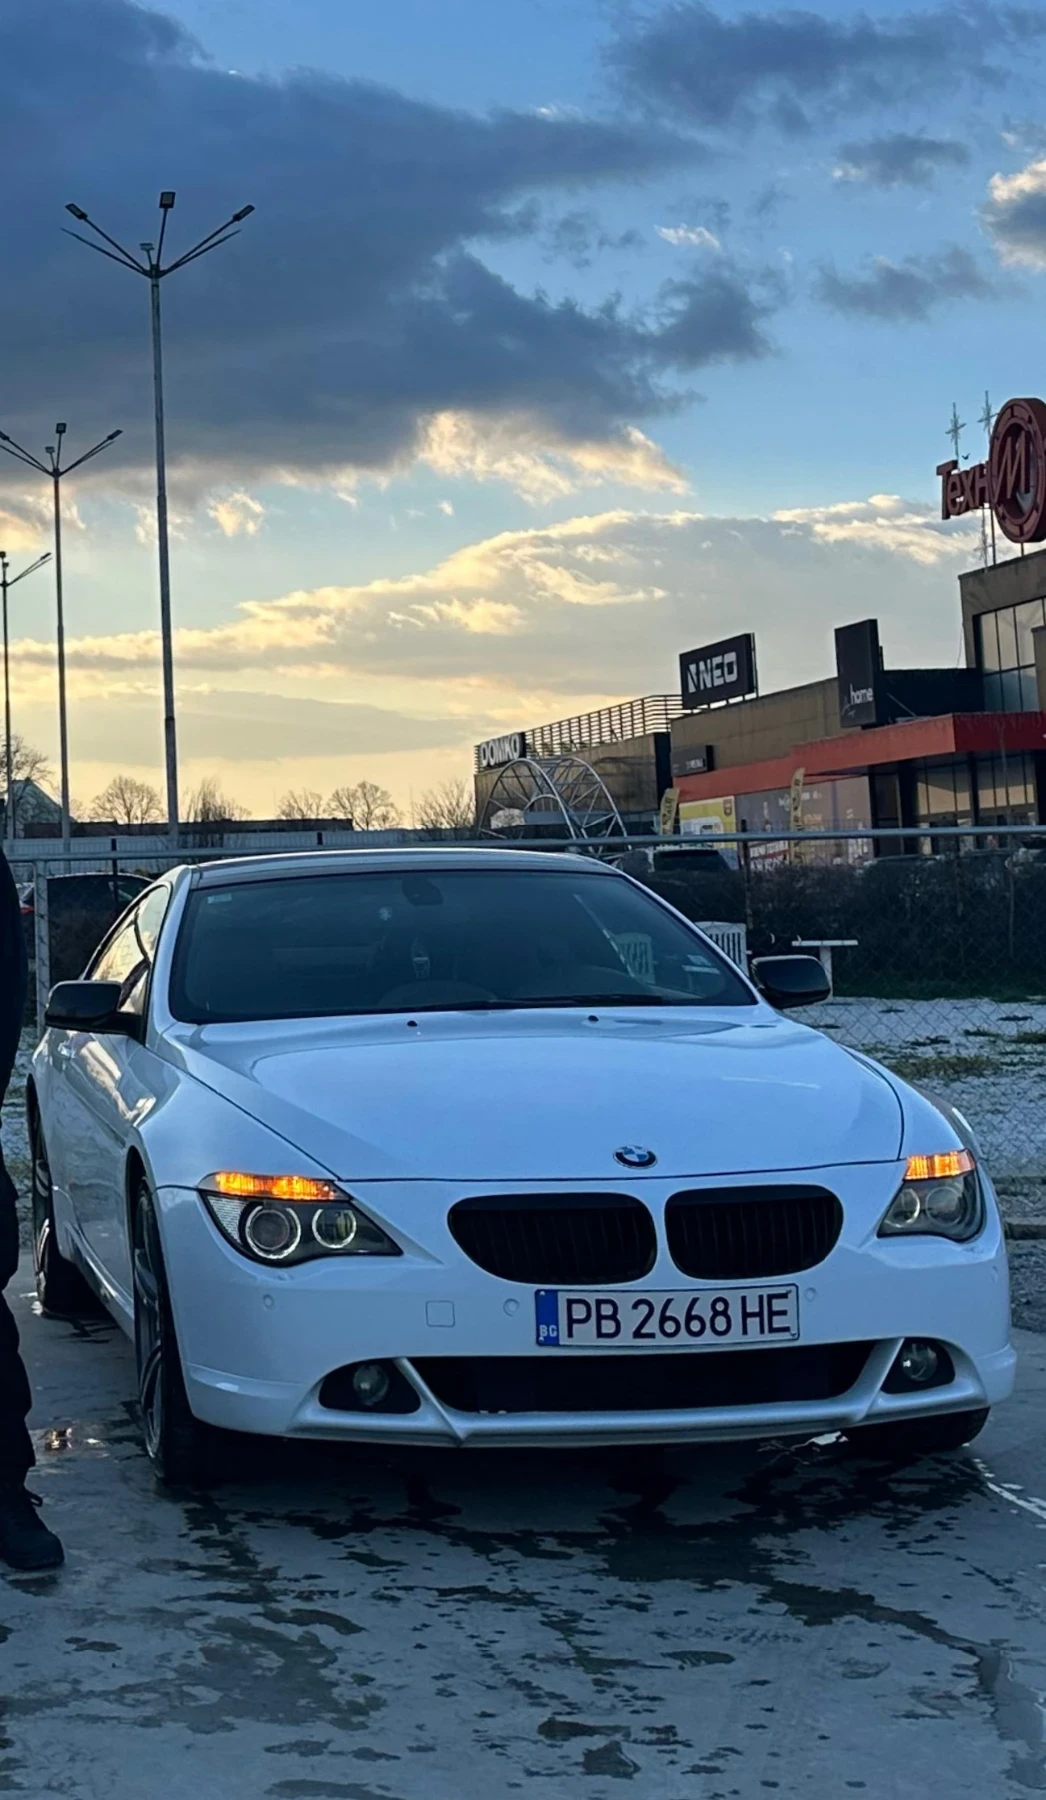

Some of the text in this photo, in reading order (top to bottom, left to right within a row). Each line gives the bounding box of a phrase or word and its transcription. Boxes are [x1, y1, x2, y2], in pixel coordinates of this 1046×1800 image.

[539, 1324, 558, 1338] BG
[565, 1292, 792, 1340] PB 2668 HE
